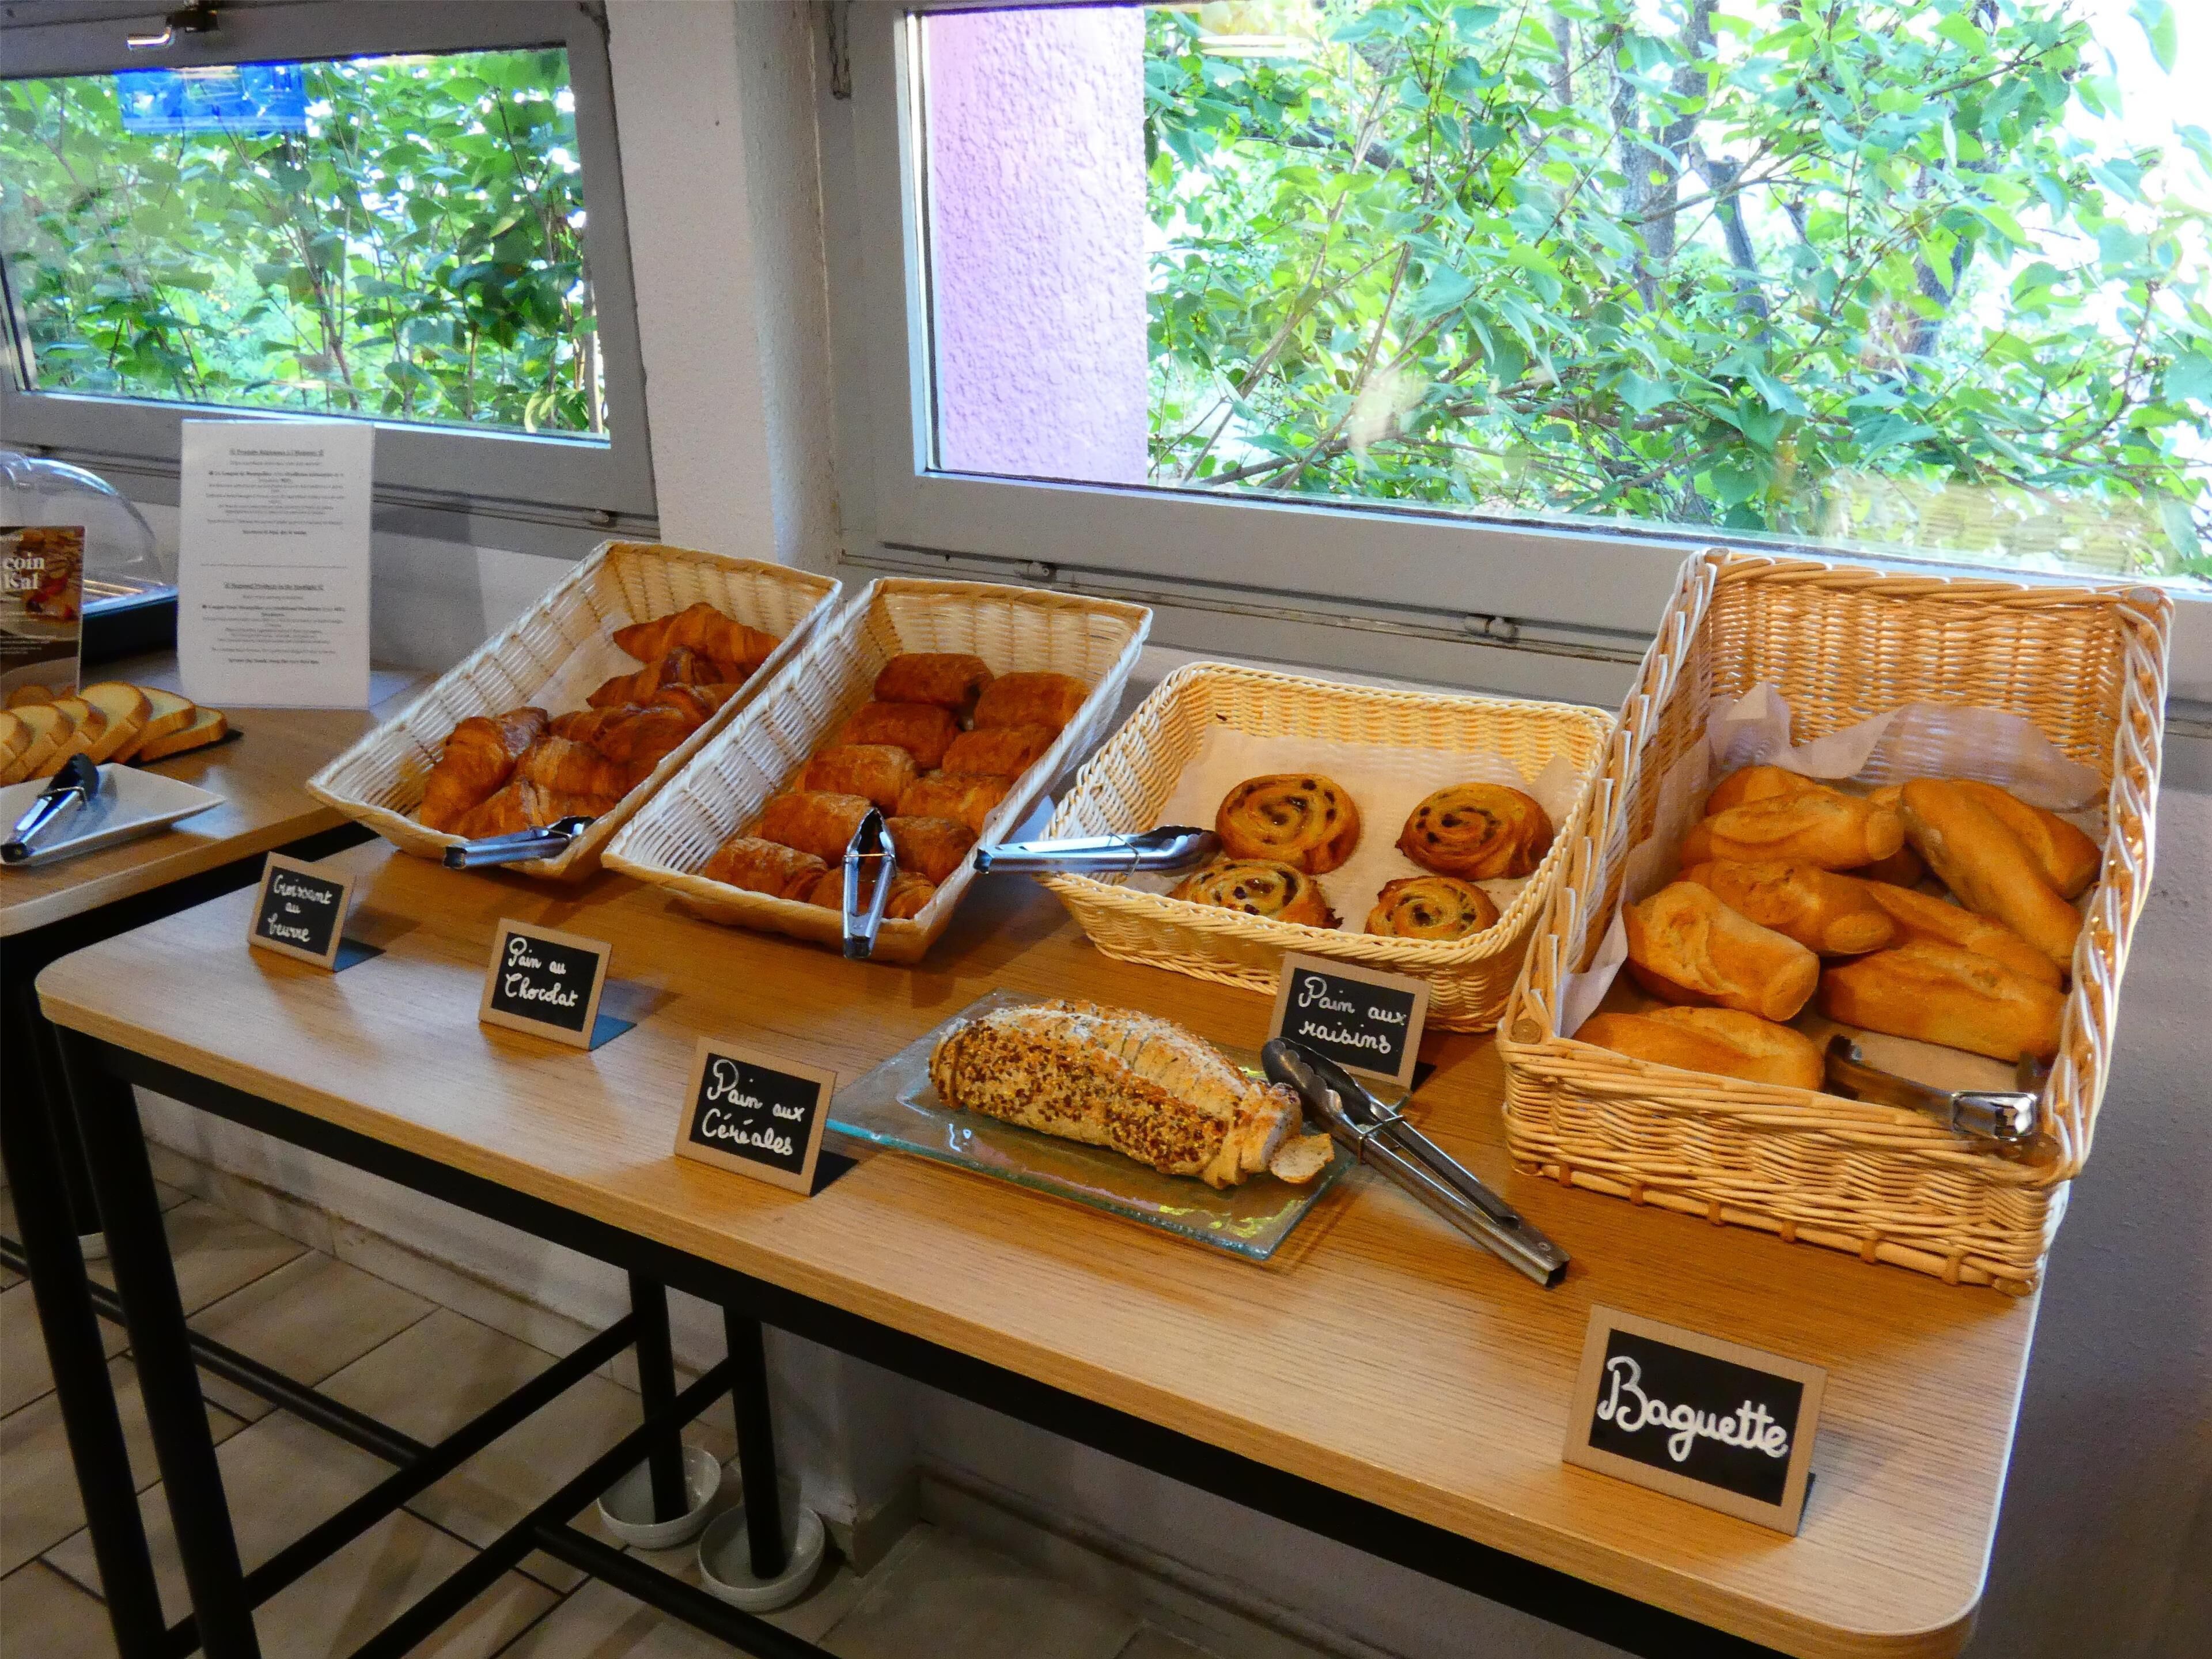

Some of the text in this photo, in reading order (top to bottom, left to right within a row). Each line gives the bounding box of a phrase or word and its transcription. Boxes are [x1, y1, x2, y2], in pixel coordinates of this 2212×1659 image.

[2, 551, 45, 570] coin
[273, 874, 333, 905] Croissant
[285, 902, 301, 914] au
[267, 912, 310, 942] beurre
[508, 937, 567, 975] Pain au
[505, 972, 578, 1007] Chocolat
[1298, 976, 1407, 1026] Pain aux
[1298, 1020, 1392, 1054] raisins
[706, 1059, 805, 1123] Pain aux
[702, 1108, 793, 1156] Céréales
[1597, 1355, 1789, 1463] Baguette
